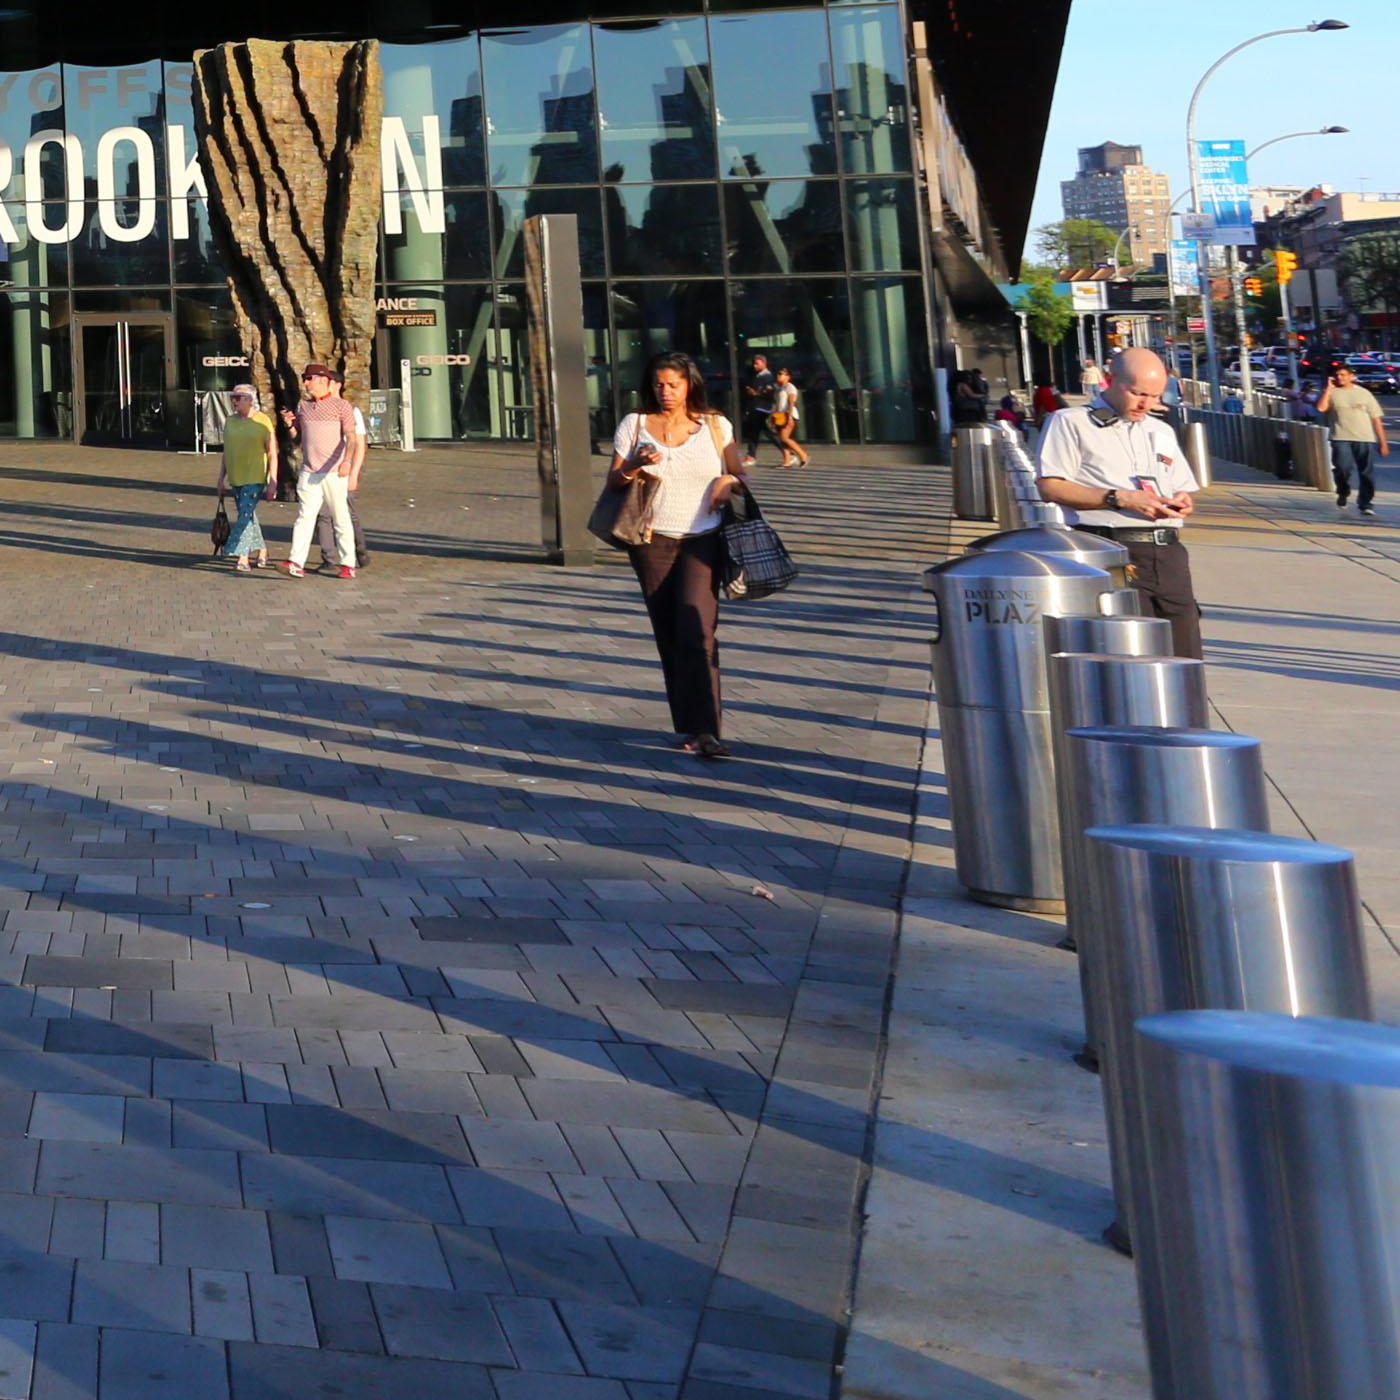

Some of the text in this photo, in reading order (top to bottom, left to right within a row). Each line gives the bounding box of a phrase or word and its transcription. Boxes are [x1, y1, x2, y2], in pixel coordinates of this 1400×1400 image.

[377, 298, 417, 311] ANCE
[415, 355, 471, 366] GEICO
[965, 601, 1042, 625] PLAZ
